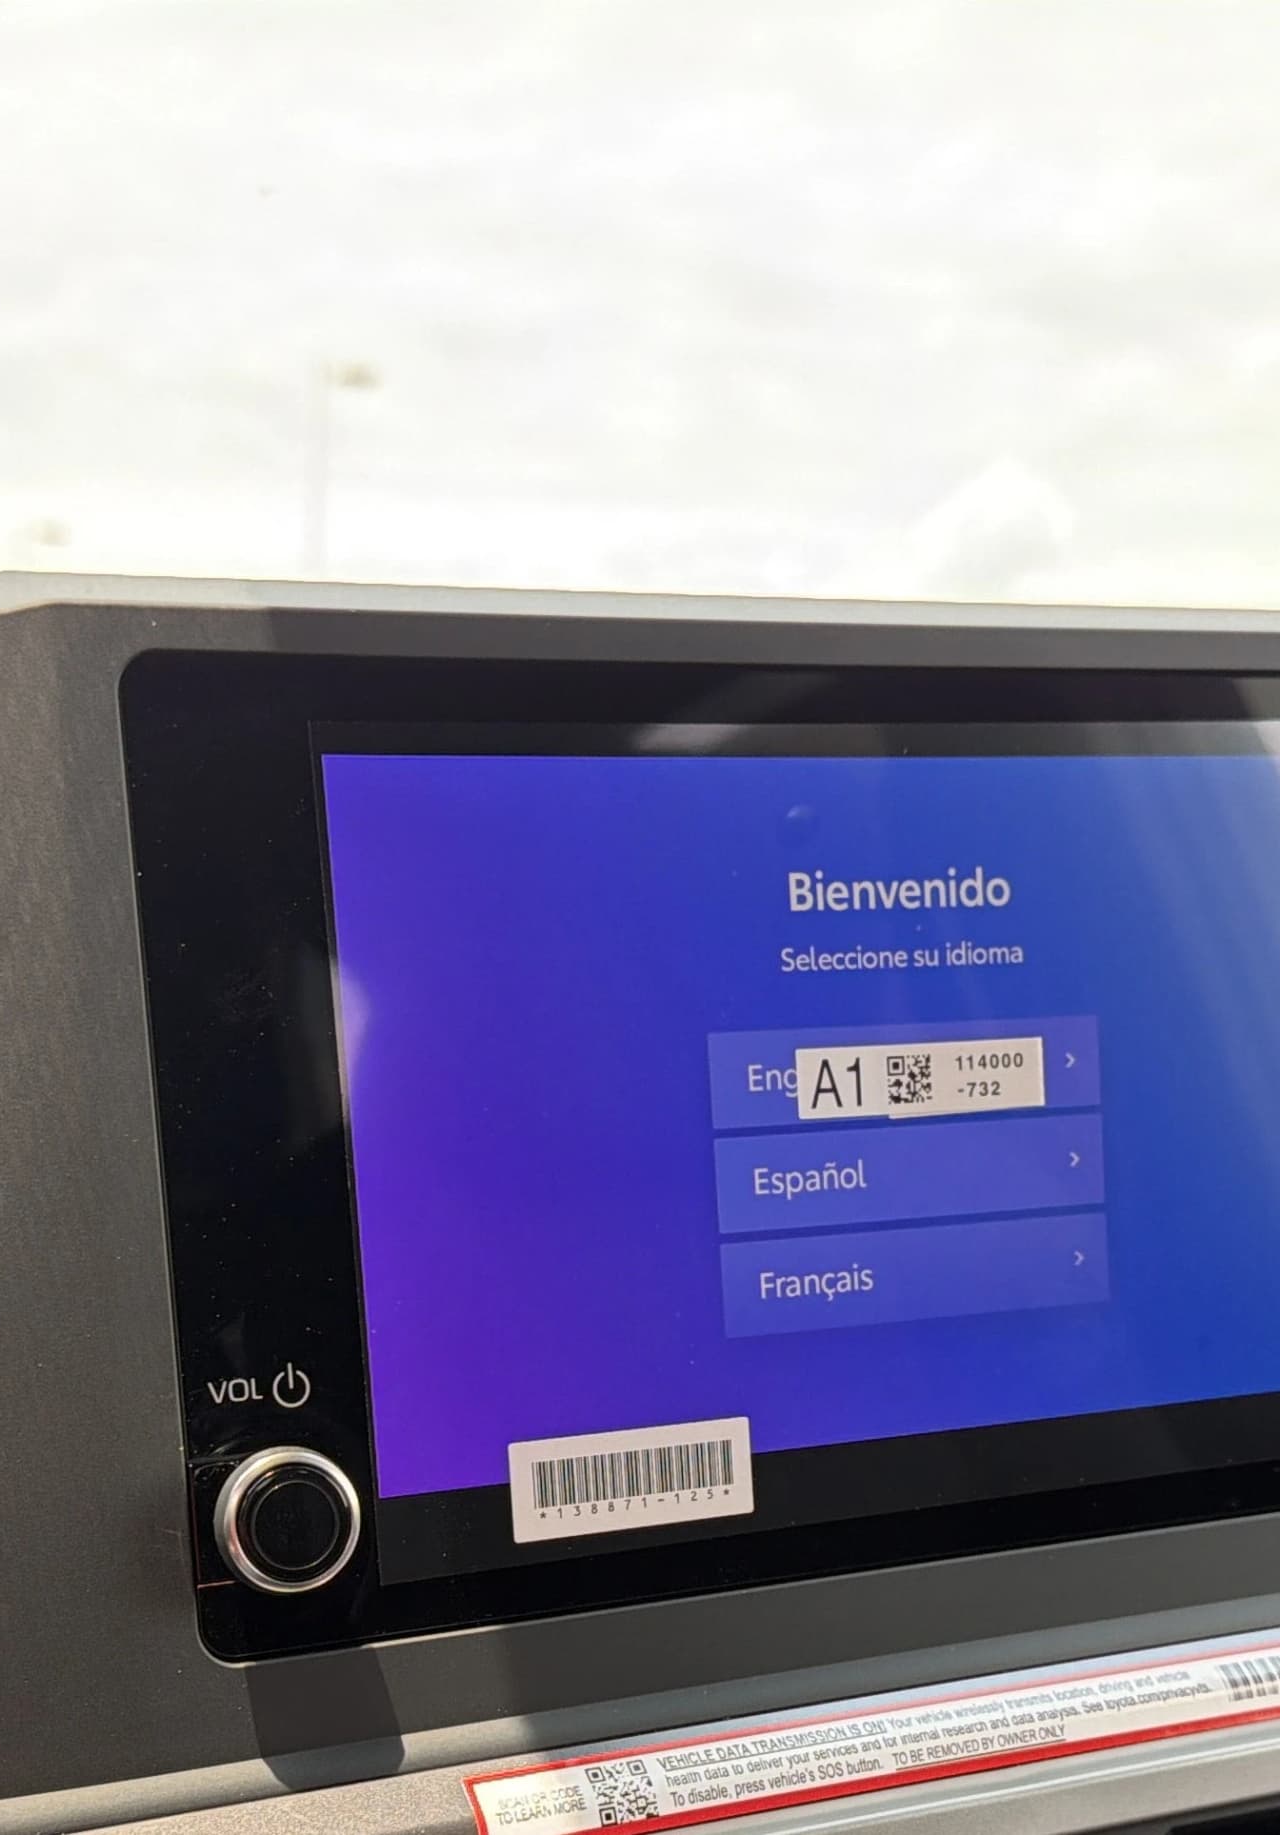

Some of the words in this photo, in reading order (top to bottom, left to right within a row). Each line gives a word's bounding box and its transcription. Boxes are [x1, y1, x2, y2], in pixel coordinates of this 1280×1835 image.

[788, 865, 1011, 912] Bienvenido
[780, 945, 909, 972] Seleccione
[913, 950, 939, 967] su
[945, 940, 1024, 966] idioma
[954, 1052, 1025, 1071] 114000
[811, 1056, 864, 1109] A1
[957, 1080, 1002, 1097] -732
[754, 1159, 867, 1200] Español
[760, 1262, 874, 1301] Français
[207, 1377, 264, 1404] VOL
[656, 1750, 717, 1769] VEHICLE
[716, 1743, 749, 1760] DATA
[752, 1727, 846, 1752] TRANSMISSION
[847, 1725, 862, 1736] IS
[886, 1717, 912, 1729] Your
[915, 1709, 953, 1725] vehicle
[955, 1700, 1005, 1718] wirelessly
[665, 1770, 702, 1788] health
[705, 1765, 729, 1780] data
[731, 1762, 744, 1775] to
[747, 1755, 784, 1772] deliver
[786, 1751, 811, 1769] your
[815, 1741, 859, 1758] services
[862, 1738, 882, 1751] and
[882, 1734, 897, 1748] for
[899, 1728, 940, 1745] internal
[942, 1720, 987, 1738] research
[990, 1716, 1010, 1730] and
[1012, 1711, 1035, 1726] data
[1082, 1701, 1104, 1714] See
[670, 1792, 685, 1808] To
[688, 1784, 733, 1805] disable,
[734, 1779, 766, 1799] press
[768, 1769, 816, 1789] vehicle's
[819, 1762, 844, 1780] SOS
[846, 1758, 884, 1776] button.
[892, 1752, 908, 1766] TO
[910, 1748, 924, 1763] BE
[926, 1739, 980, 1759] REMOVED
[981, 1735, 996, 1749] BY
[997, 1729, 1037, 1746] OWNER
[1038, 1722, 1065, 1740] ONLY
[496, 1811, 514, 1825] TO
[515, 1805, 552, 1823] LEARN
[553, 1798, 587, 1815] MORE
[550, 1785, 583, 1801] CODE
